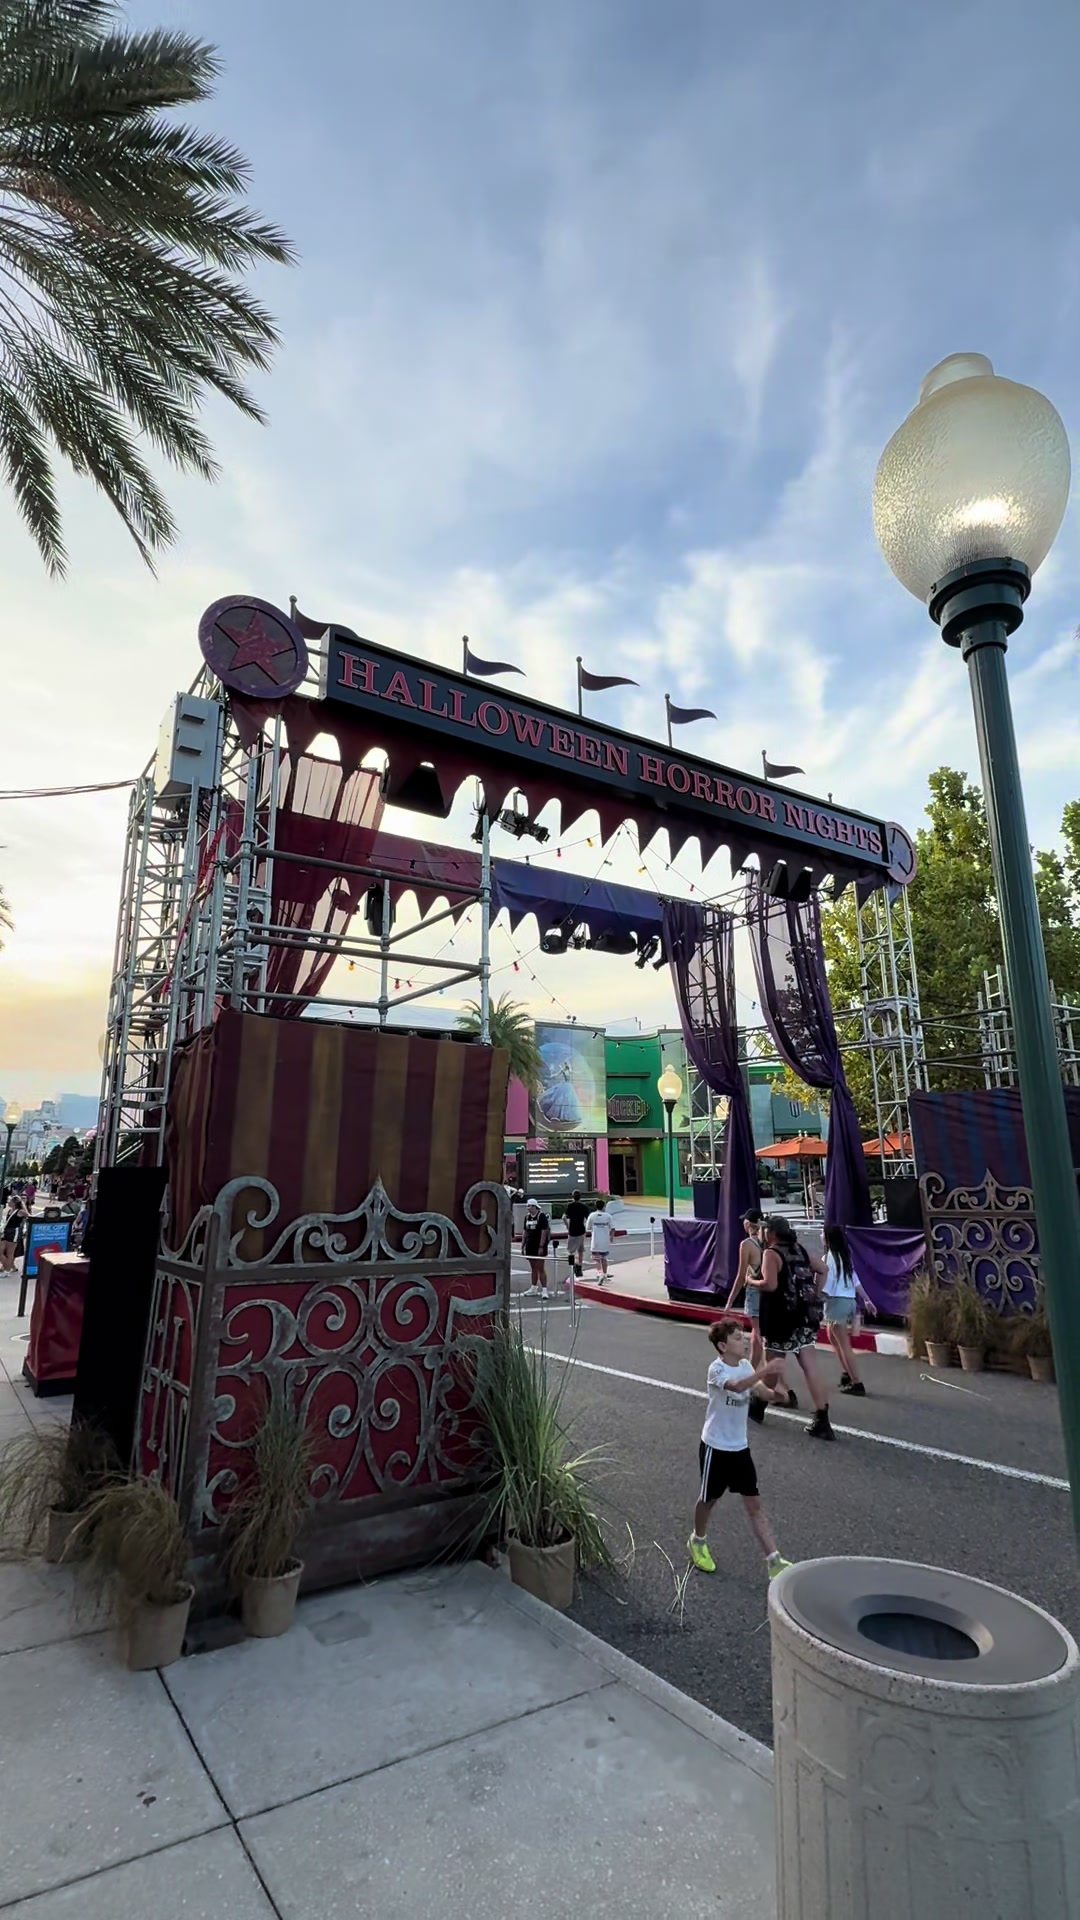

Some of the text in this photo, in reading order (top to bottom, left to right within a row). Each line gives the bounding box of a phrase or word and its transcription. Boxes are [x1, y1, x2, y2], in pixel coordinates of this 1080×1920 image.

[337, 650, 884, 856] HALLOWEEN HORROR NIGHTS
